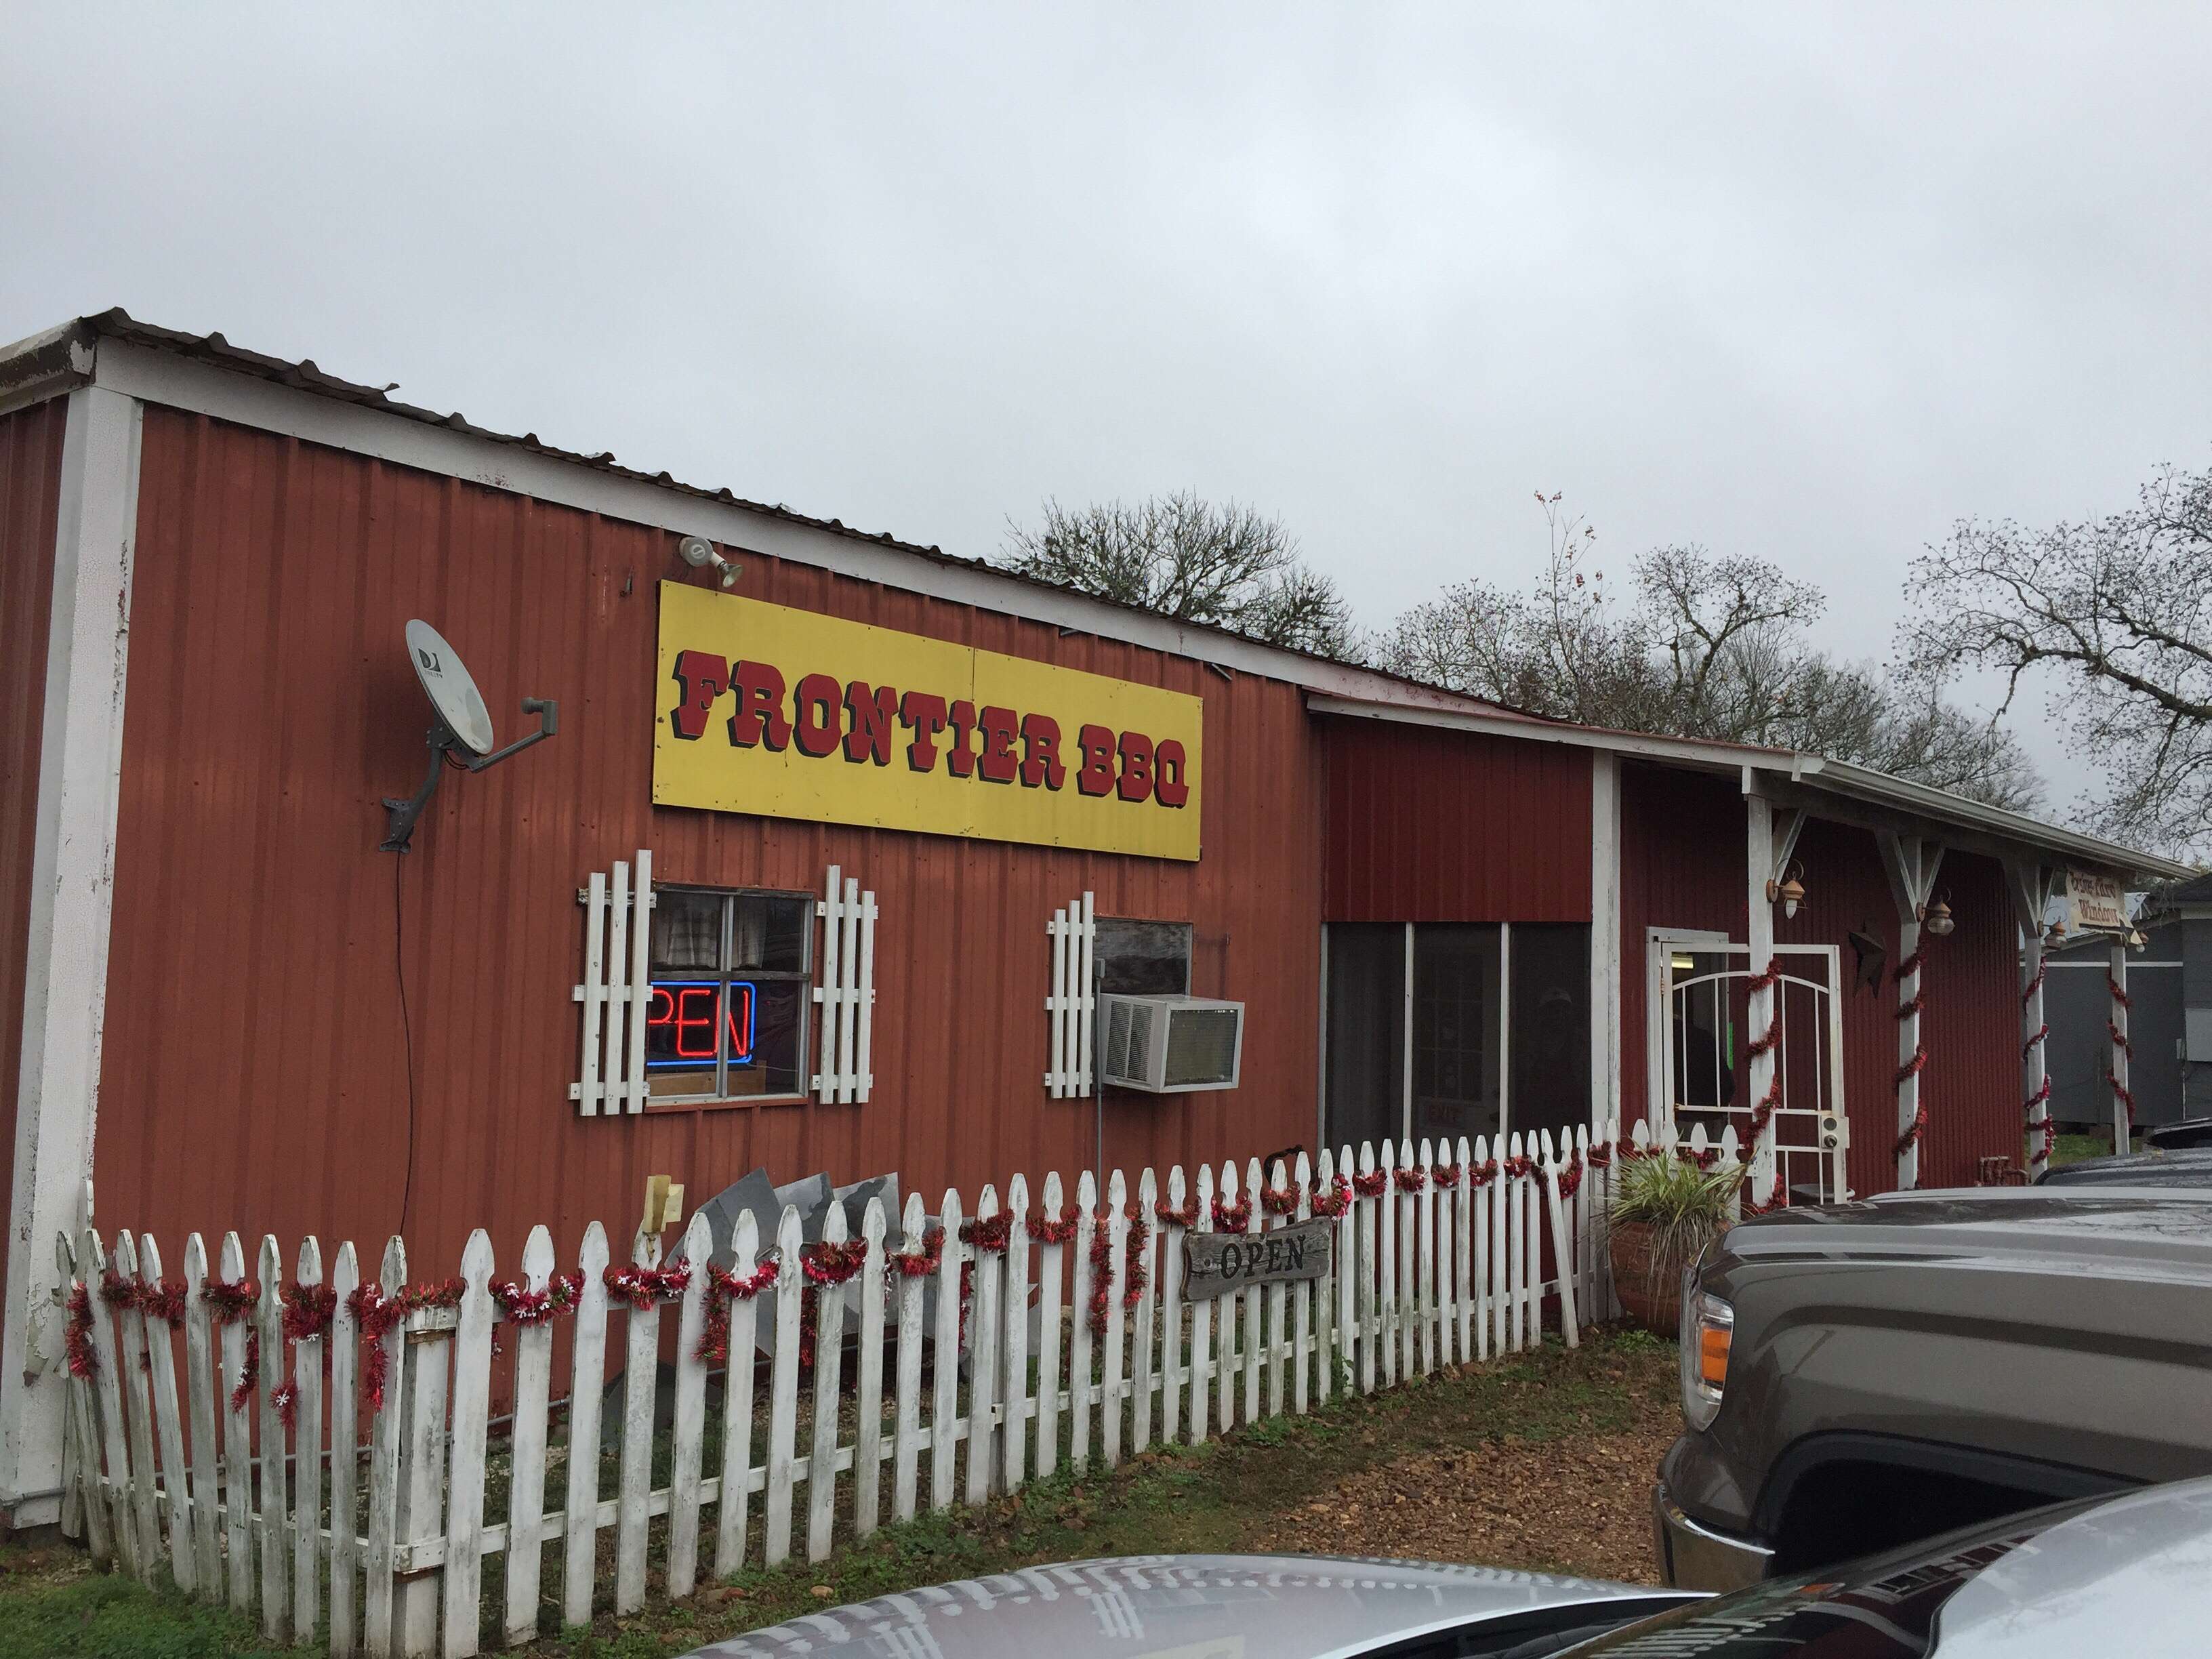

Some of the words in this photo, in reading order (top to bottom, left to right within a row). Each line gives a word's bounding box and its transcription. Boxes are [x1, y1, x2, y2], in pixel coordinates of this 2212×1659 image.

[670, 649, 1067, 792] FRONTIER
[1076, 724, 1190, 809] BBQ
[2078, 899, 2118, 923] Window
[648, 989, 749, 1056] PEN
[1221, 1234, 1306, 1279] OPEN
